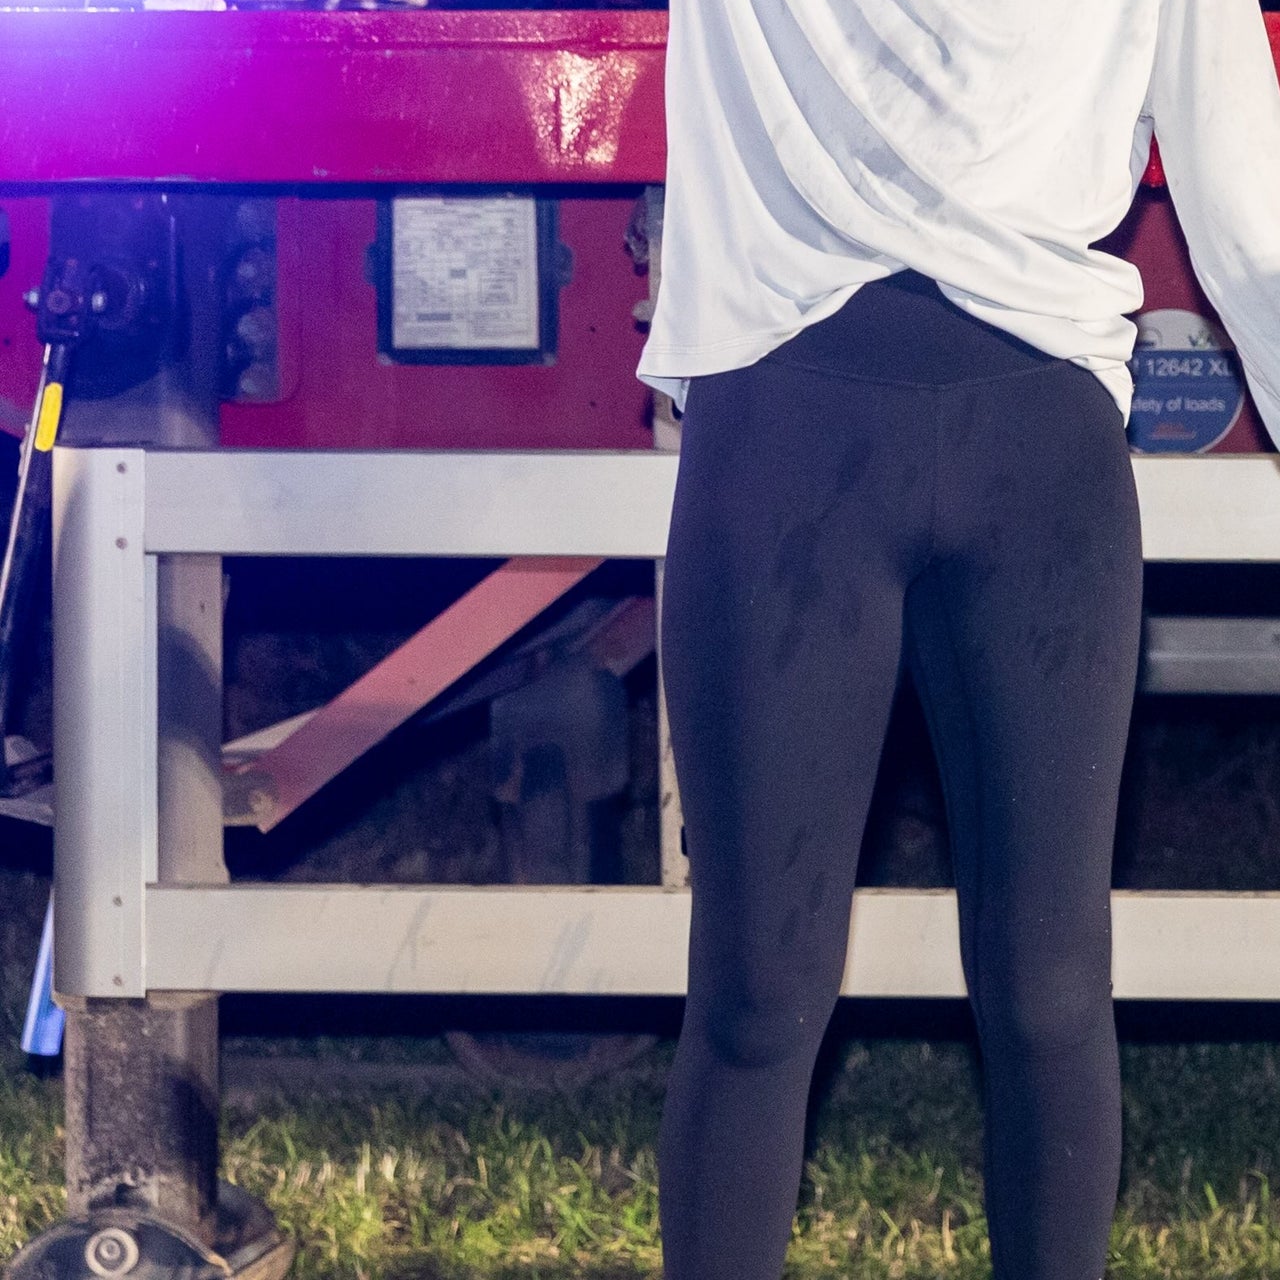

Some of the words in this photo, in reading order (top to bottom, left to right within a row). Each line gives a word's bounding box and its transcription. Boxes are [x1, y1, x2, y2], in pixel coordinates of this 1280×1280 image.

[1144, 358, 1204, 377] 12642
[1165, 395, 1183, 412] of
[1185, 397, 1226, 412] loads
